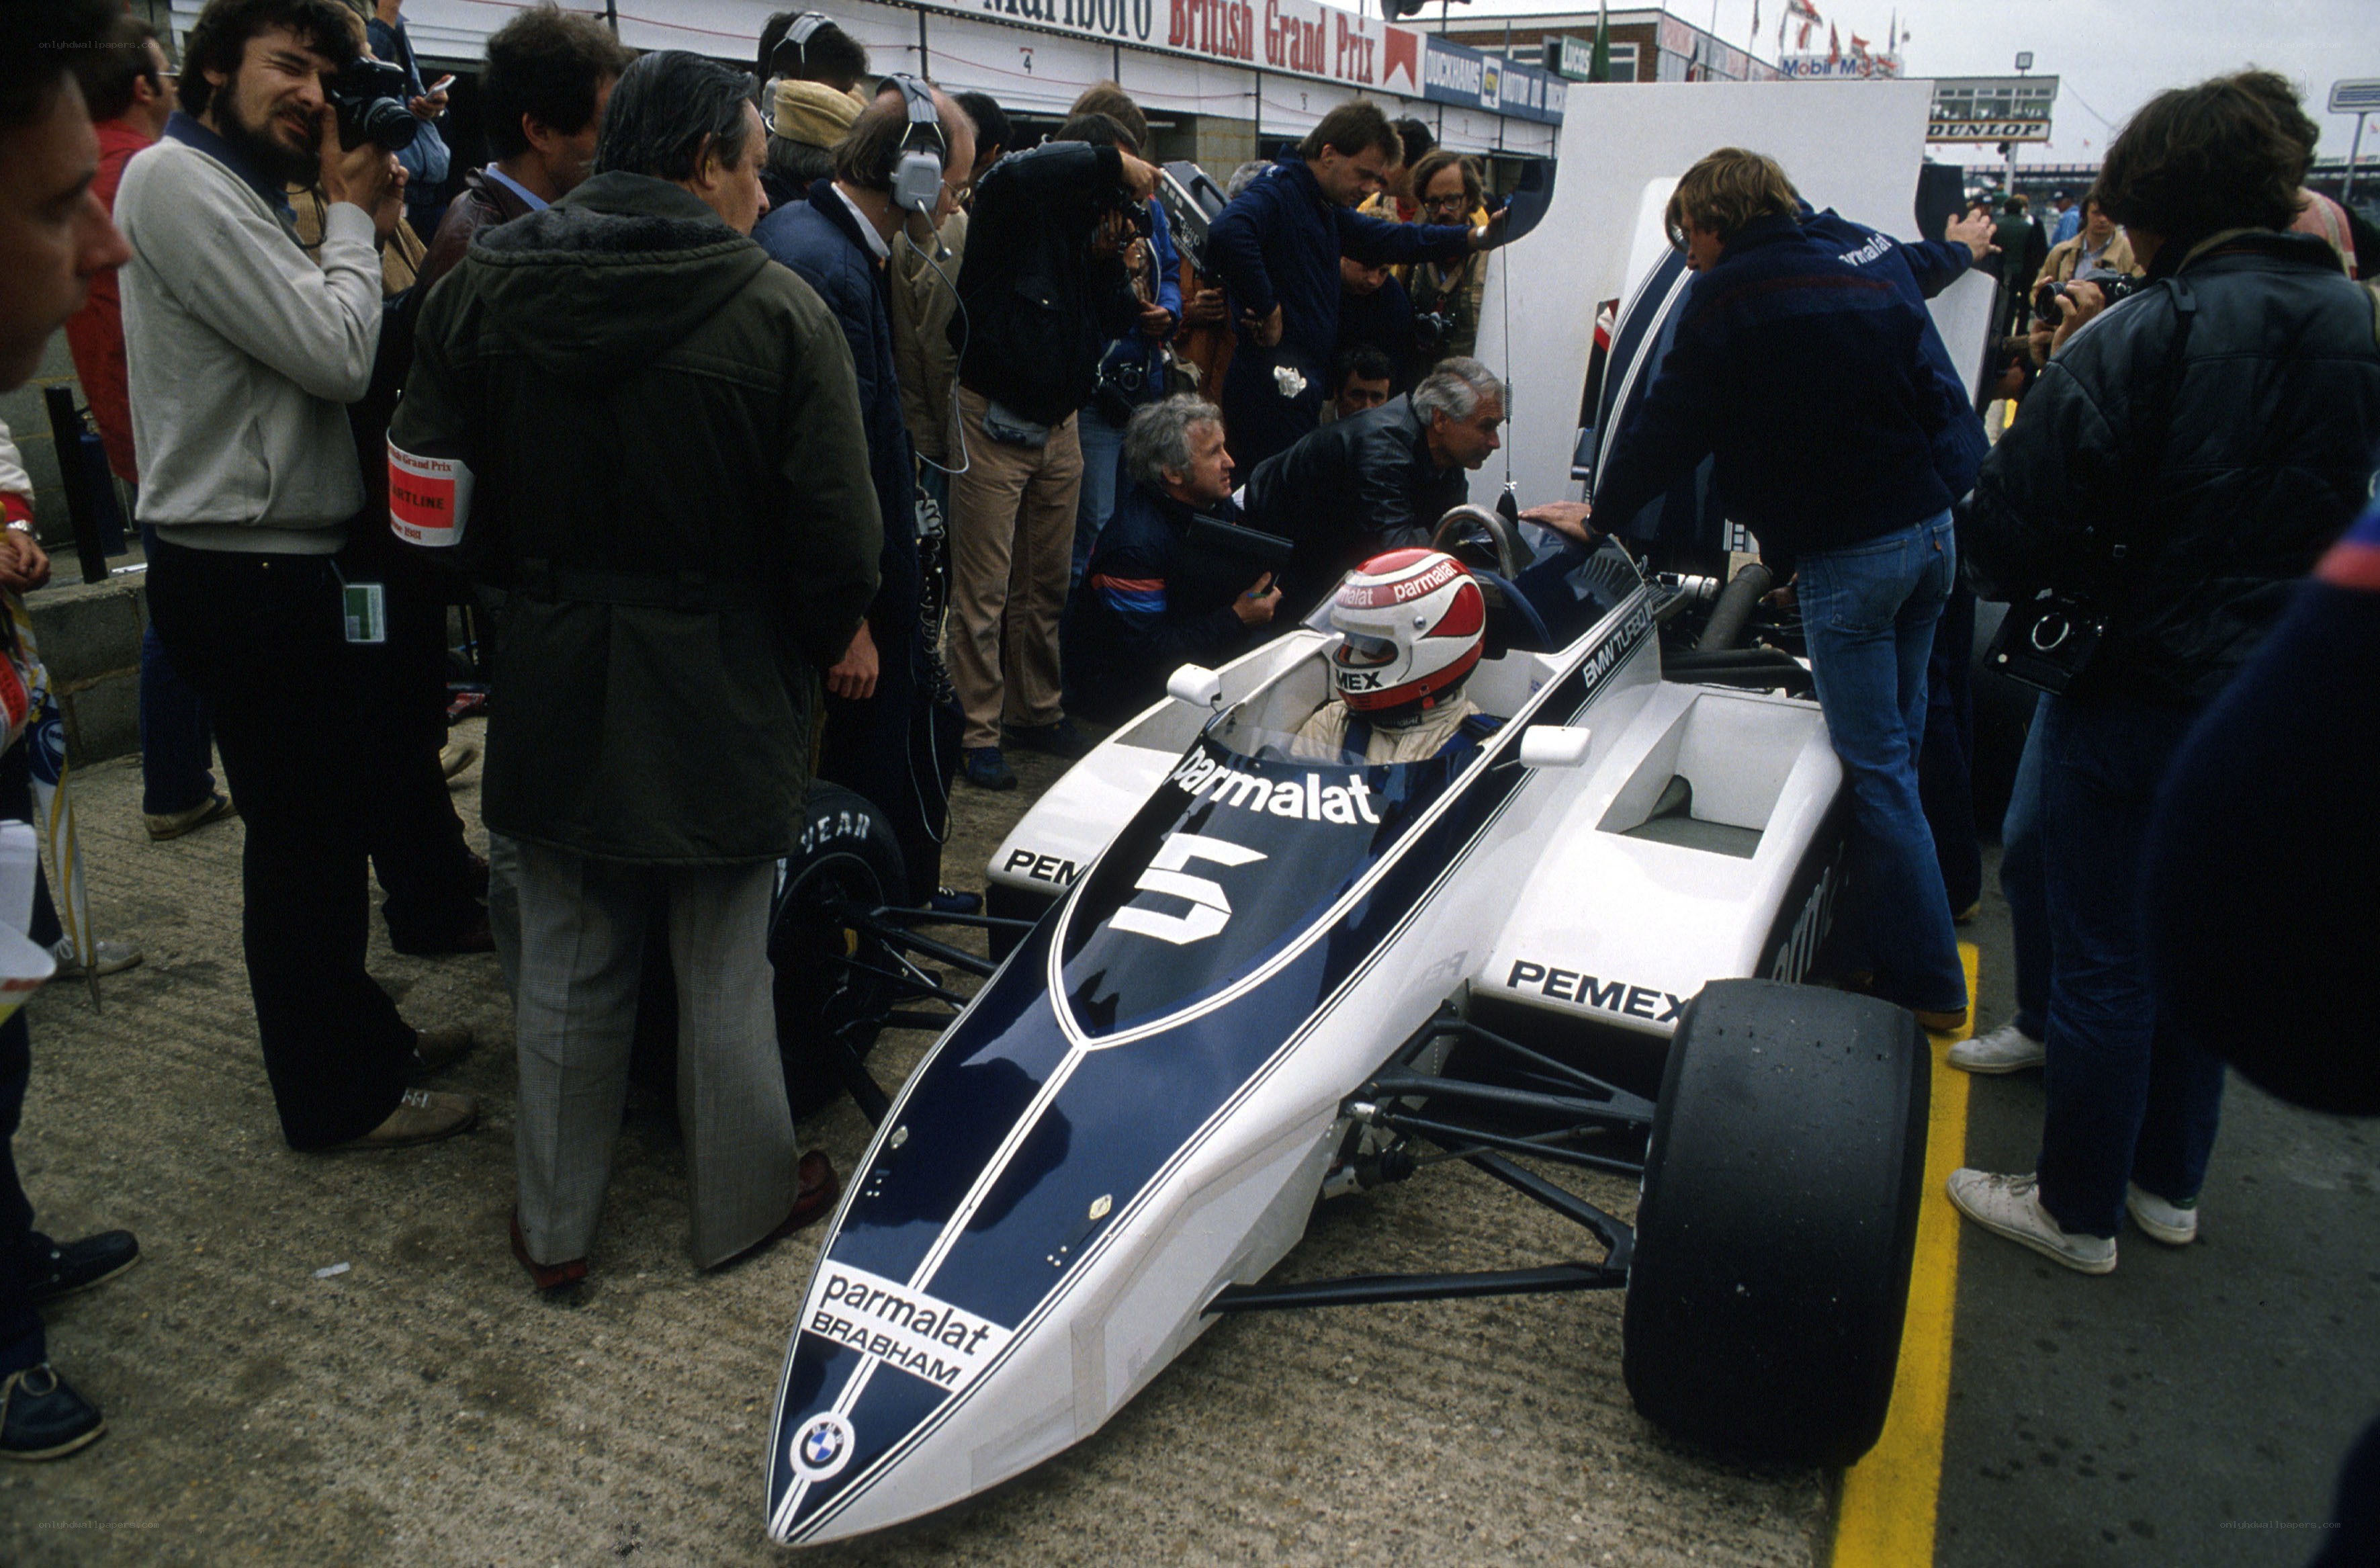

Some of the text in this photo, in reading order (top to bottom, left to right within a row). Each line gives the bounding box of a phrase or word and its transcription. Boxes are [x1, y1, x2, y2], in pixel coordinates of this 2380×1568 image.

[1023, 54, 1032, 74] 4
[1168, 0, 1253, 60] British
[1266, 0, 1325, 75] Grand
[1335, 11, 1374, 83] Prix
[1426, 48, 1481, 95] DUCKHAMS
[1782, 58, 1832, 76] Mobil
[1927, 124, 2042, 136] DUNLOP
[402, 453, 452, 472] Grand Prix
[390, 480, 445, 511] ARTLINE
[1393, 562, 1458, 603] parmalat
[1583, 607, 1646, 689] BMW TURBO
[1163, 745, 1380, 824] parmalat
[1108, 832, 1269, 945] 5
[1506, 959, 1691, 1023] PEMEX
[819, 1274, 990, 1356] parmalat
[810, 1311, 963, 1385] BRABHAM
[811, 1422, 844, 1445] BMW
